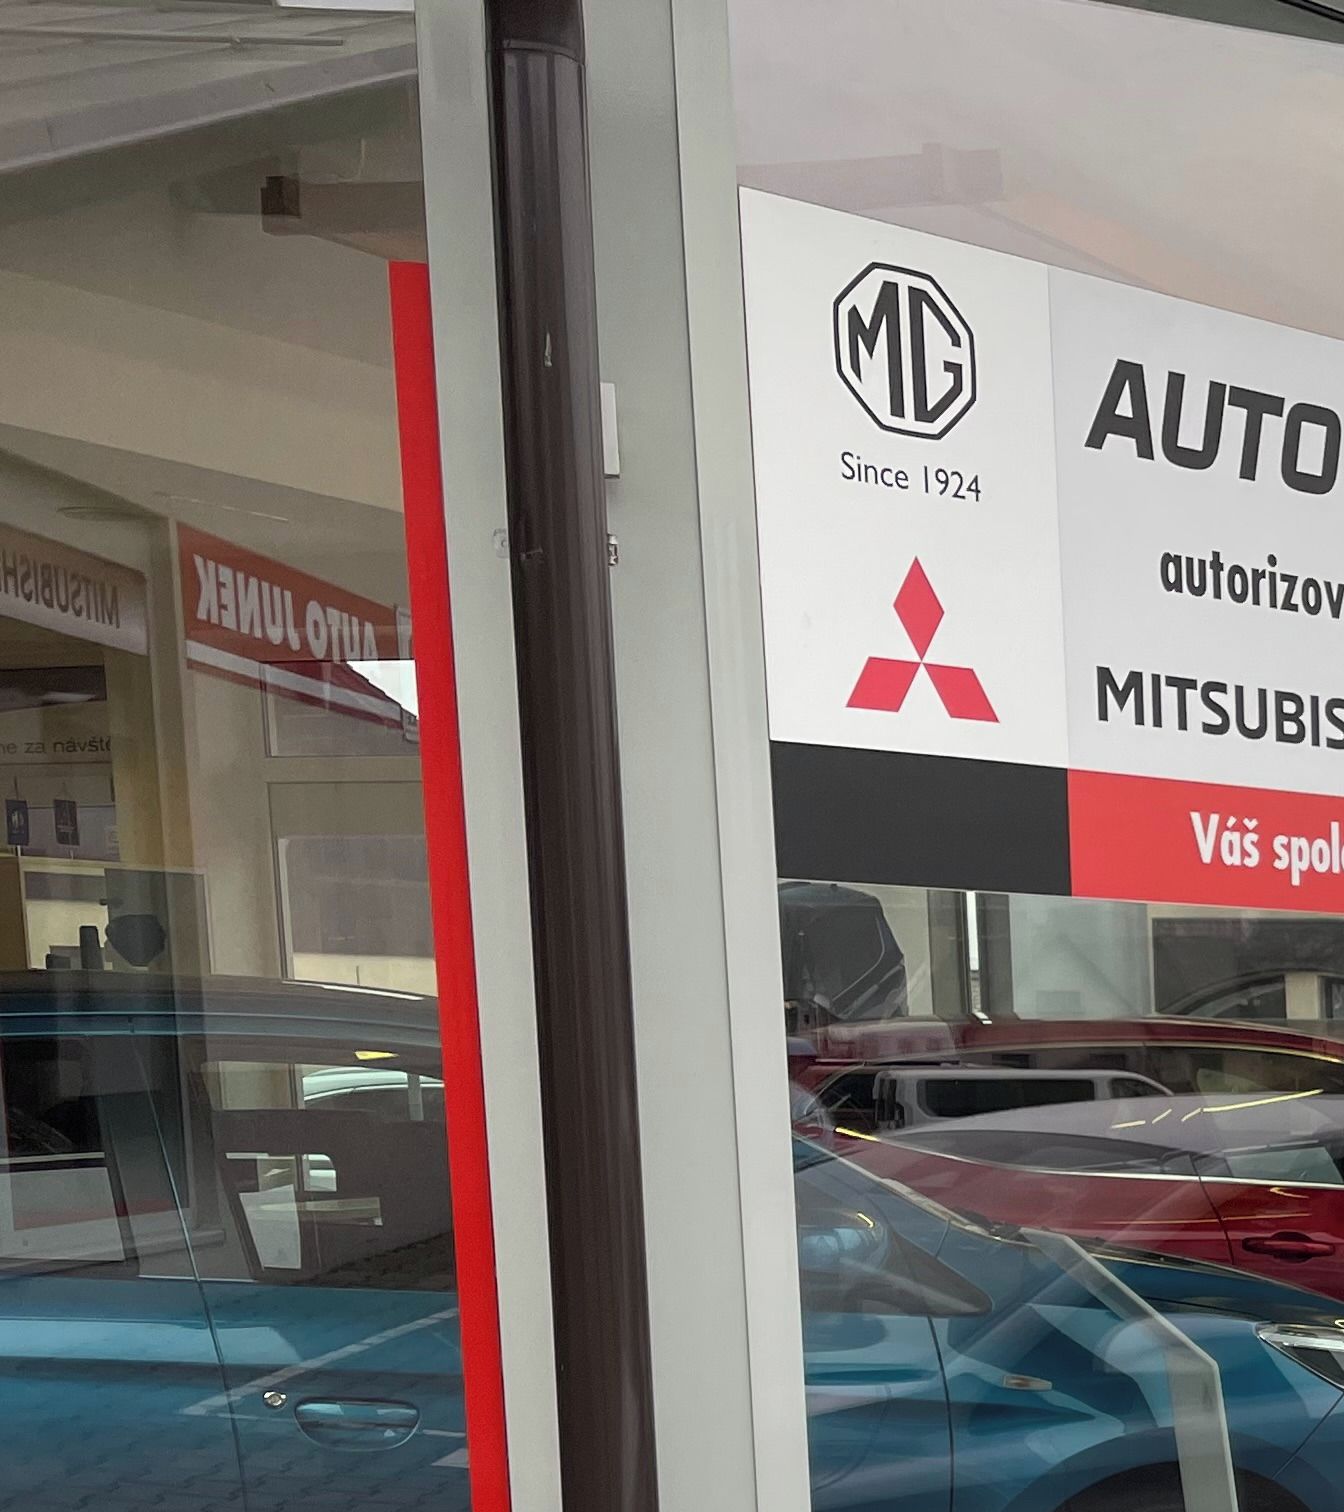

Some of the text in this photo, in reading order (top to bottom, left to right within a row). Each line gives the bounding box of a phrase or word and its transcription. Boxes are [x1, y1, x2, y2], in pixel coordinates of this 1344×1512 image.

[845, 279, 964, 425] MG
[1084, 358, 1343, 496] AUTO
[839, 451, 983, 503] Since 1924
[1189, 810, 1262, 870] Váš
